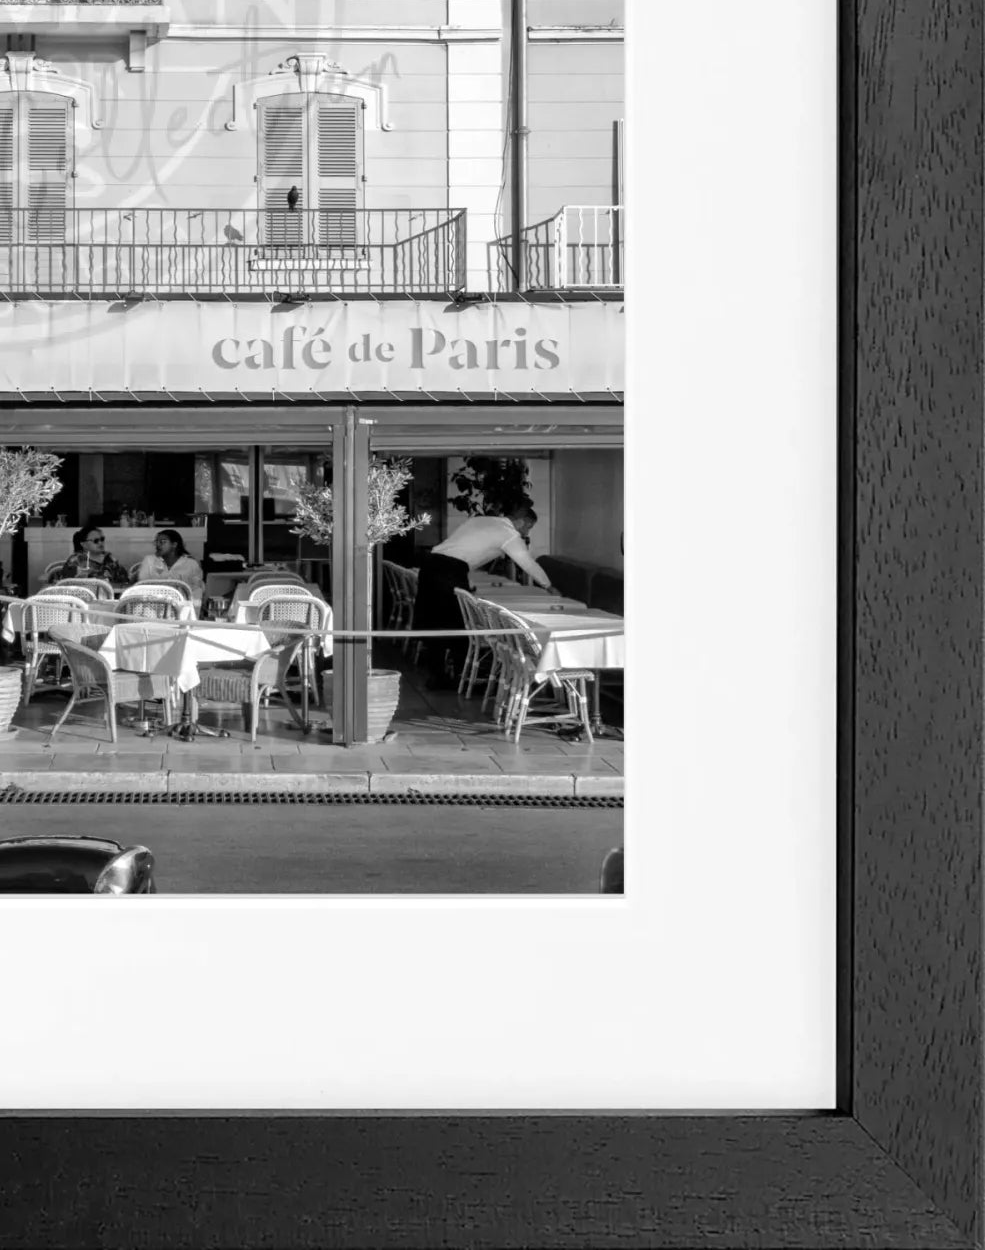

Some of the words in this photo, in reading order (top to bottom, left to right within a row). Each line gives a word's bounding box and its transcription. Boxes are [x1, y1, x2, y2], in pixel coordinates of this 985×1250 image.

[211, 325, 332, 370] café
[348, 333, 395, 363] de
[409, 327, 561, 370] Paris
